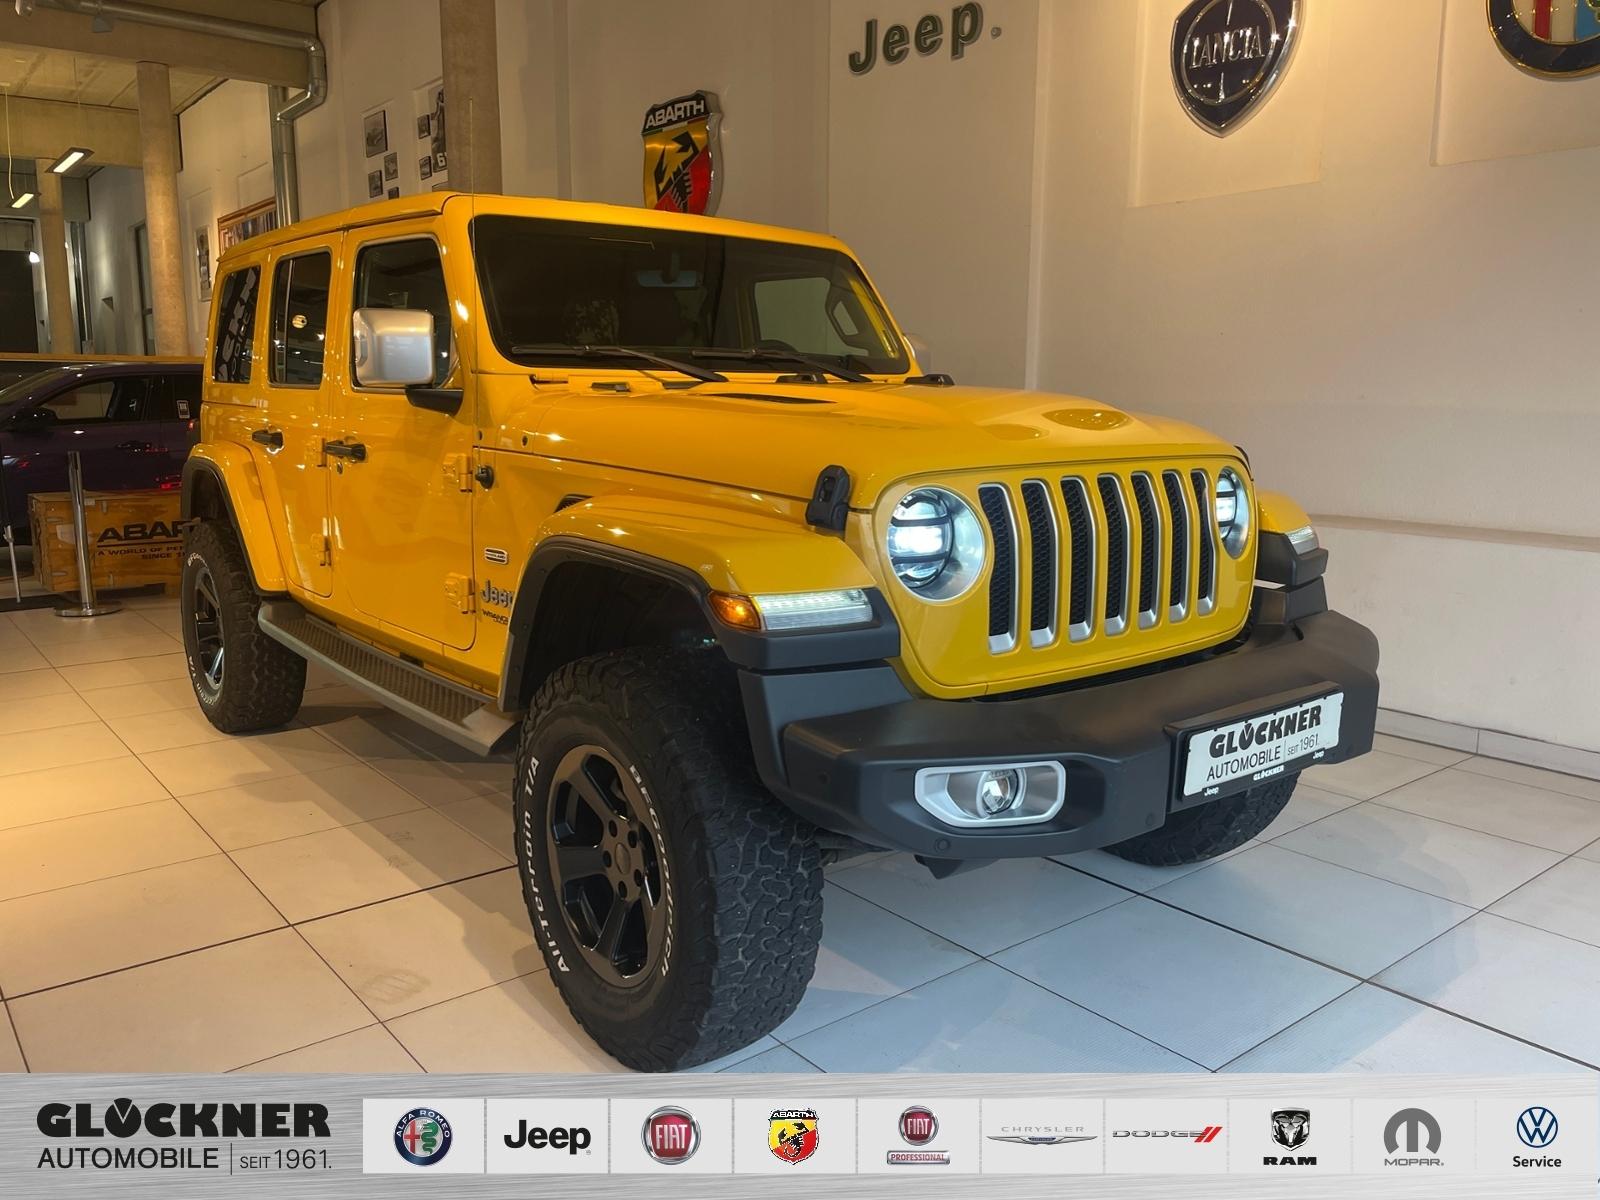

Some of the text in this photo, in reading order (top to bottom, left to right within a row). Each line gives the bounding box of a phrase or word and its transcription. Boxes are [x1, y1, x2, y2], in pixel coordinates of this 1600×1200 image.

[1189, 25, 1266, 70] LANCIA
[645, 100, 705, 129] ABARTH
[1206, 745, 1281, 782] AUTOMOBILE
[522, 756, 571, 973] All-Terrain T/A
